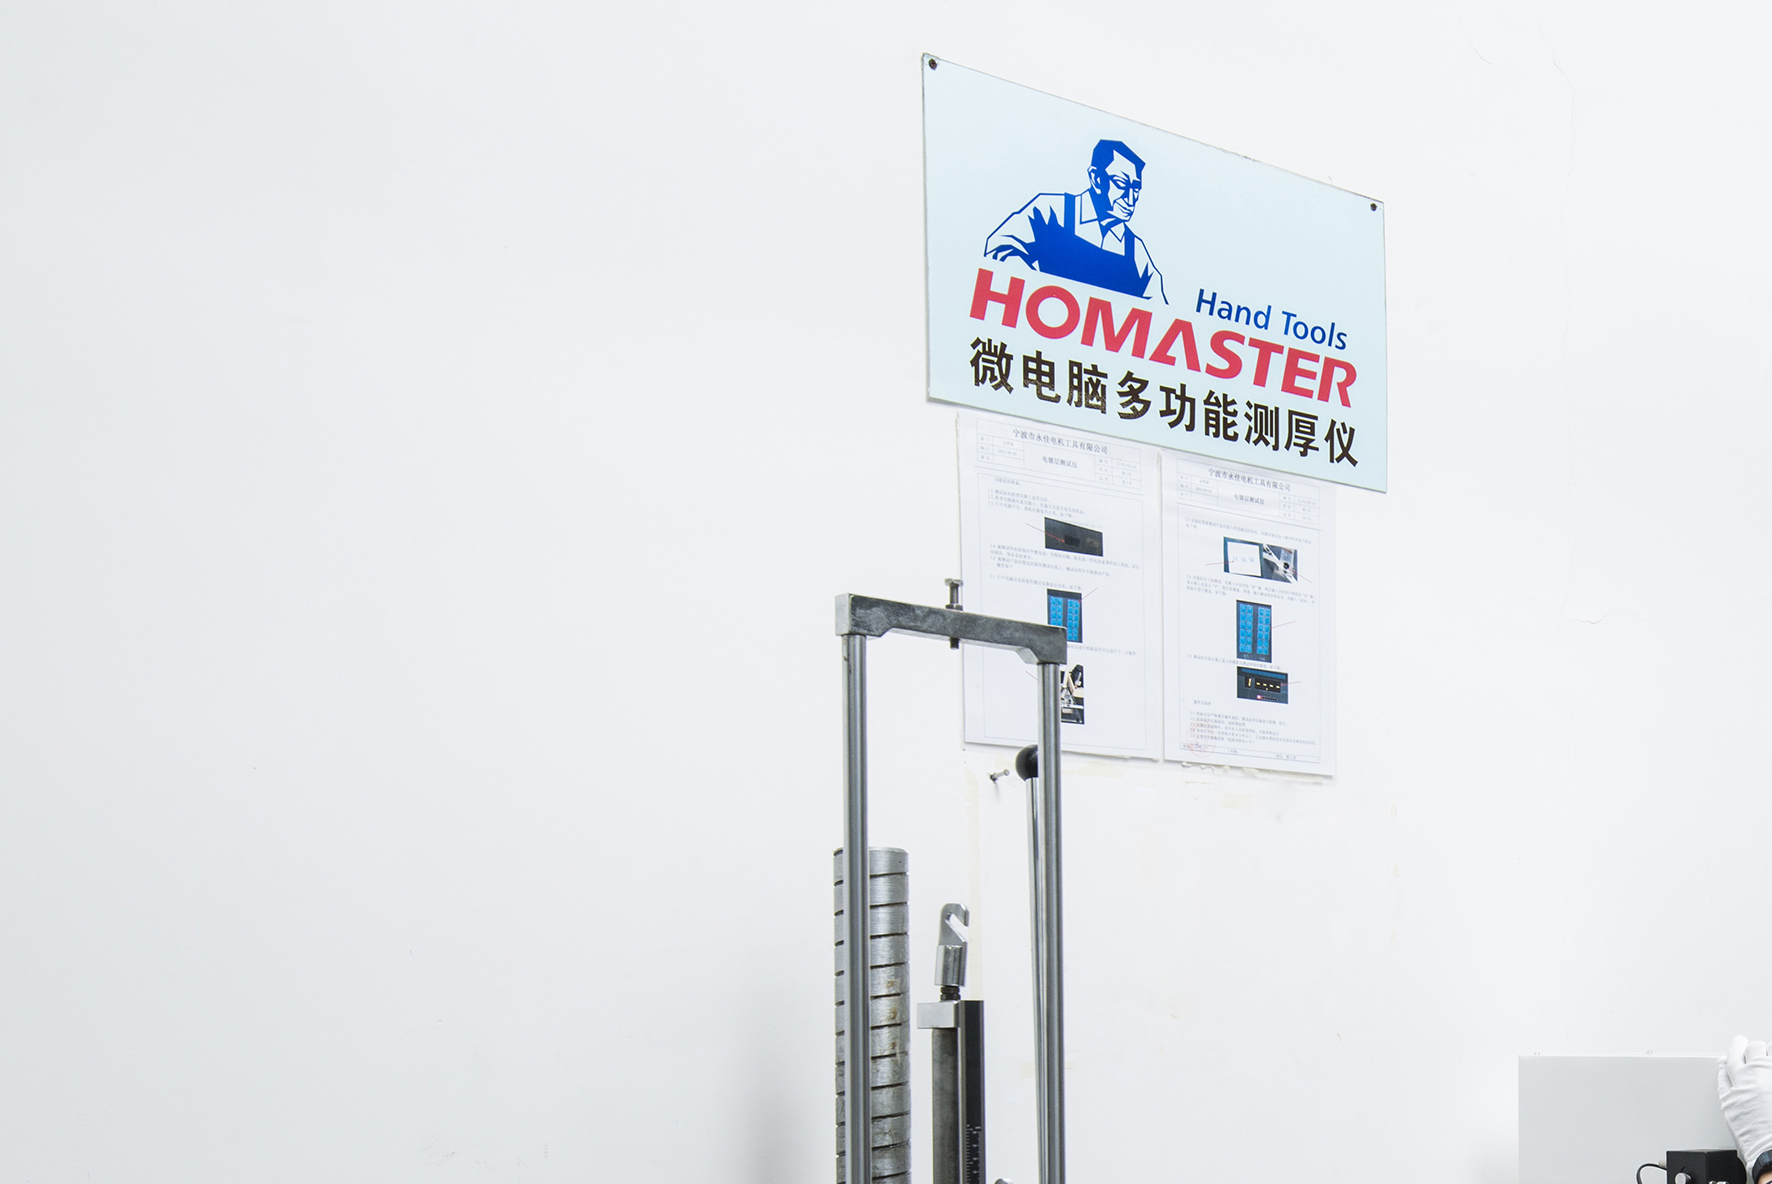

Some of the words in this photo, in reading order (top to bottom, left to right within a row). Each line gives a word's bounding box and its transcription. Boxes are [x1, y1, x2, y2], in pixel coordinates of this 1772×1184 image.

[969, 268, 1357, 408] HOMASTER
[1196, 288, 1271, 330] Hand
[1282, 311, 1347, 351] Tools
[969, 337, 1358, 467] 微电脑多功能测厚仪
